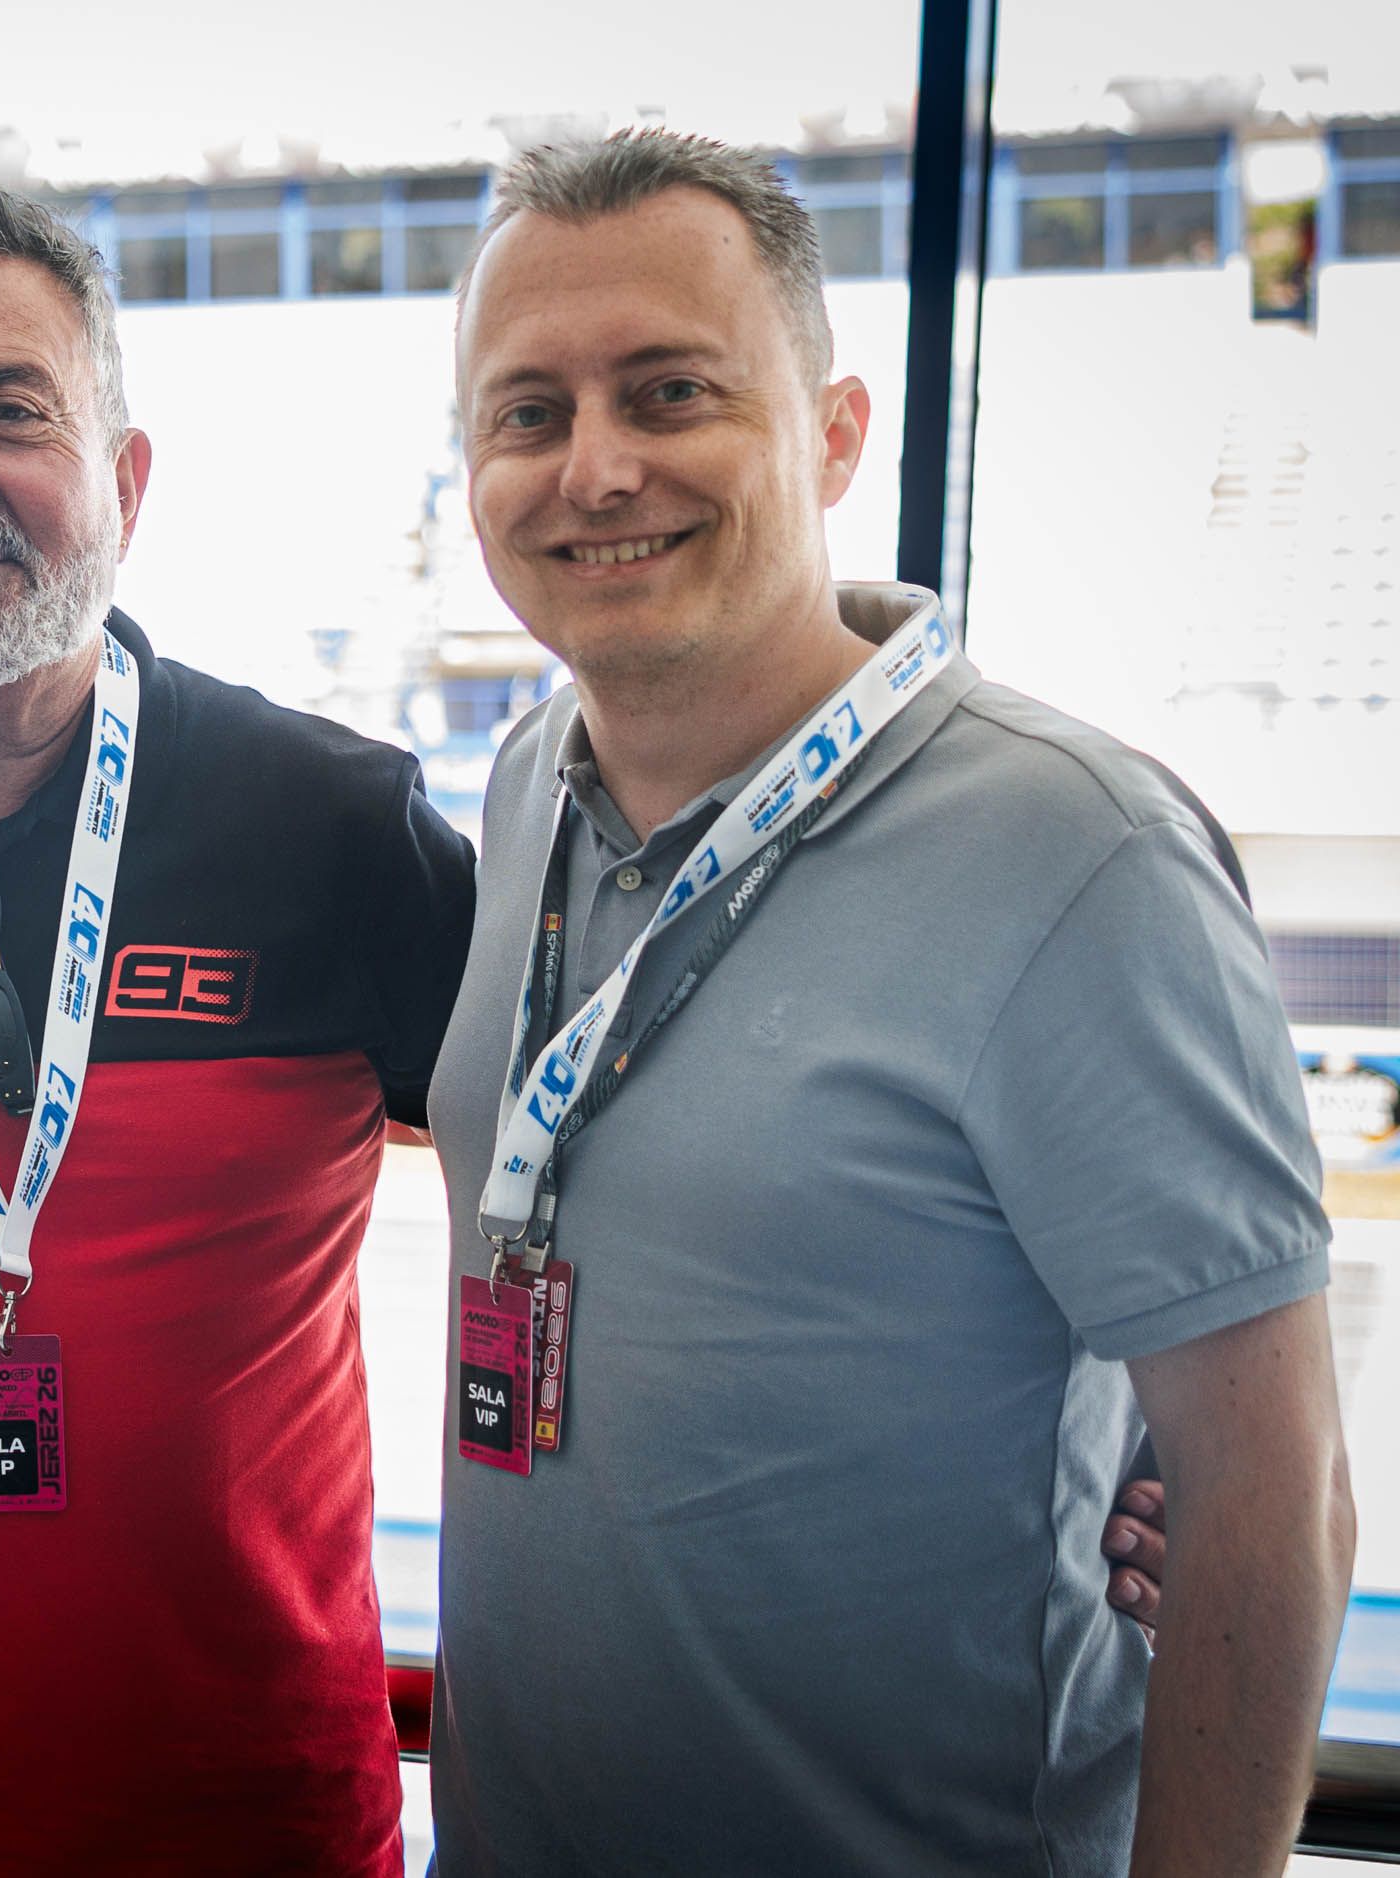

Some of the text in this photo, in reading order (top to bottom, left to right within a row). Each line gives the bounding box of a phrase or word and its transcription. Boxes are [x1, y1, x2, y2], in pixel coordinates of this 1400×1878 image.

[97, 707, 129, 786] 40
[798, 698, 863, 785] 40
[99, 785, 114, 843] JEREZ
[67, 882, 104, 964] 40
[545, 932, 557, 971] SPAIN
[71, 962, 87, 1024] JEREZ
[108, 946, 257, 1022] 93
[39, 1062, 76, 1150] 40
[527, 1049, 577, 1136] 40
[541, 1281, 567, 1410] 2026
[37, 1366, 61, 1495] JEREZ 26
[468, 1382, 506, 1408] SALA
[475, 1407, 499, 1428] VIP
